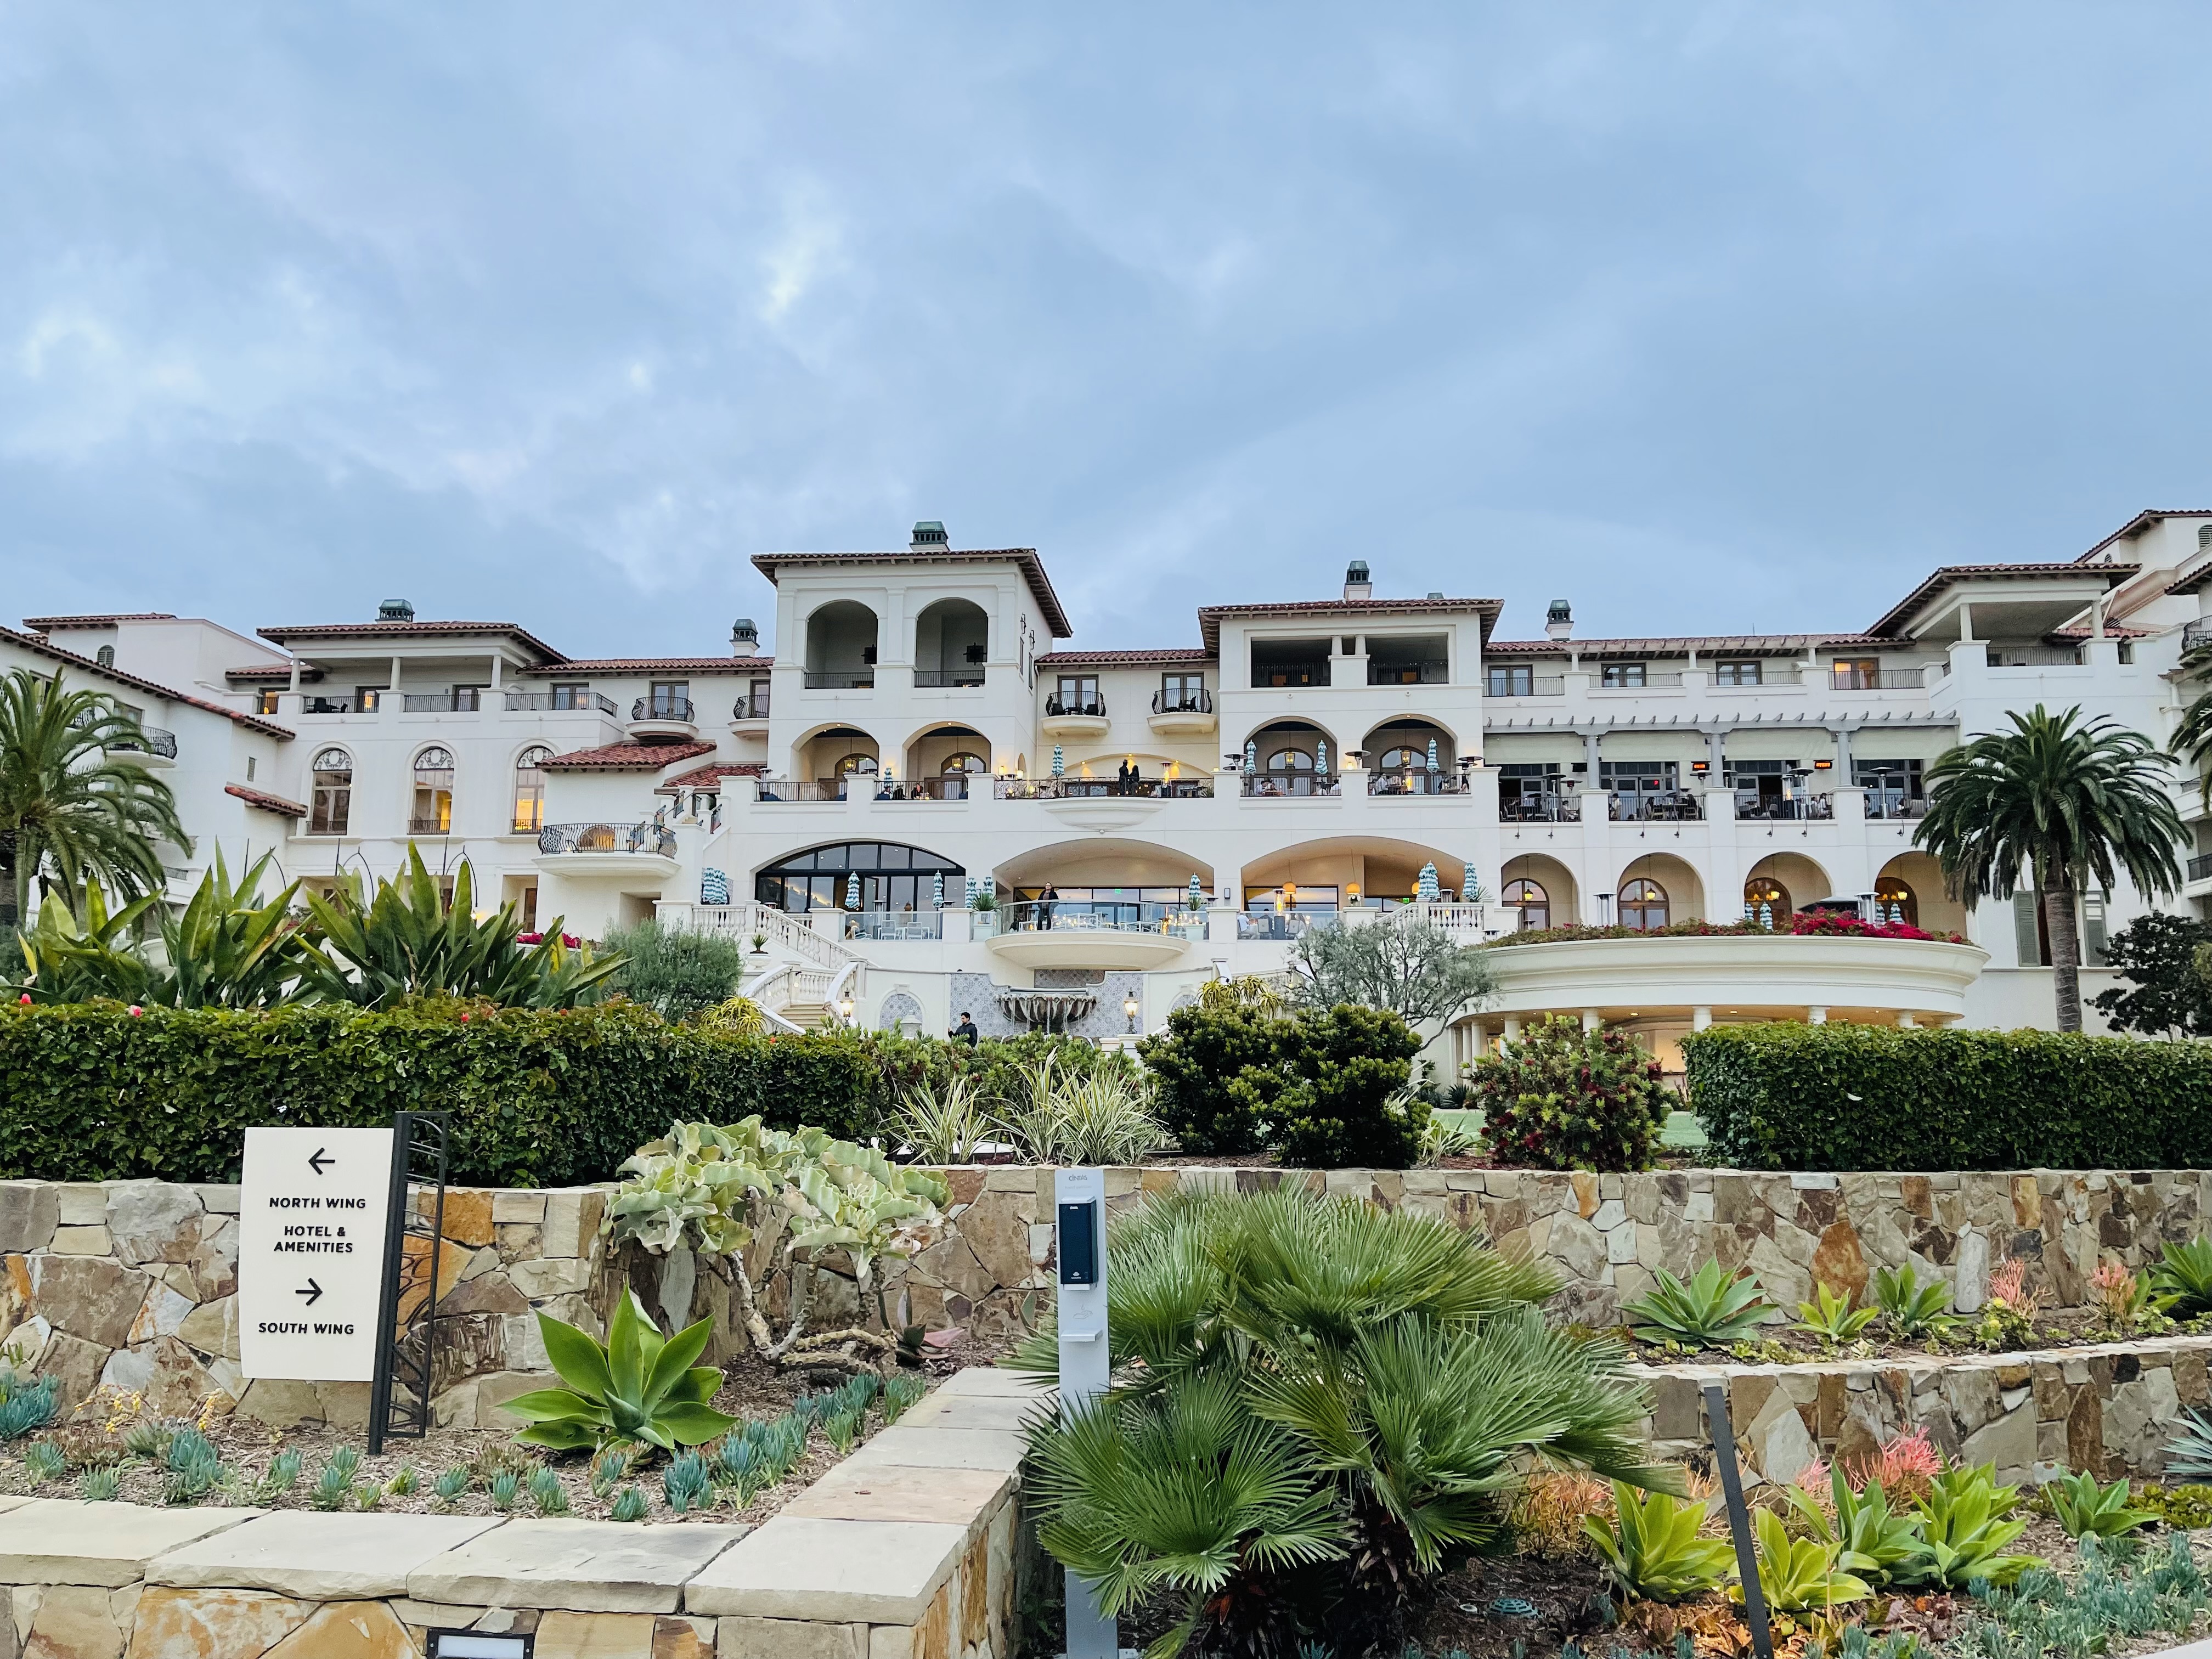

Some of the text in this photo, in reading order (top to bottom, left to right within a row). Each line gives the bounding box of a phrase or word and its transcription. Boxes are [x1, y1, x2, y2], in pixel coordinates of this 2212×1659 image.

[269, 1197, 366, 1209] NORTH WING
[284, 1226, 346, 1237] HOTEL &
[274, 1242, 353, 1253] AMENITIES
[258, 1322, 354, 1335] SOUTH WING
